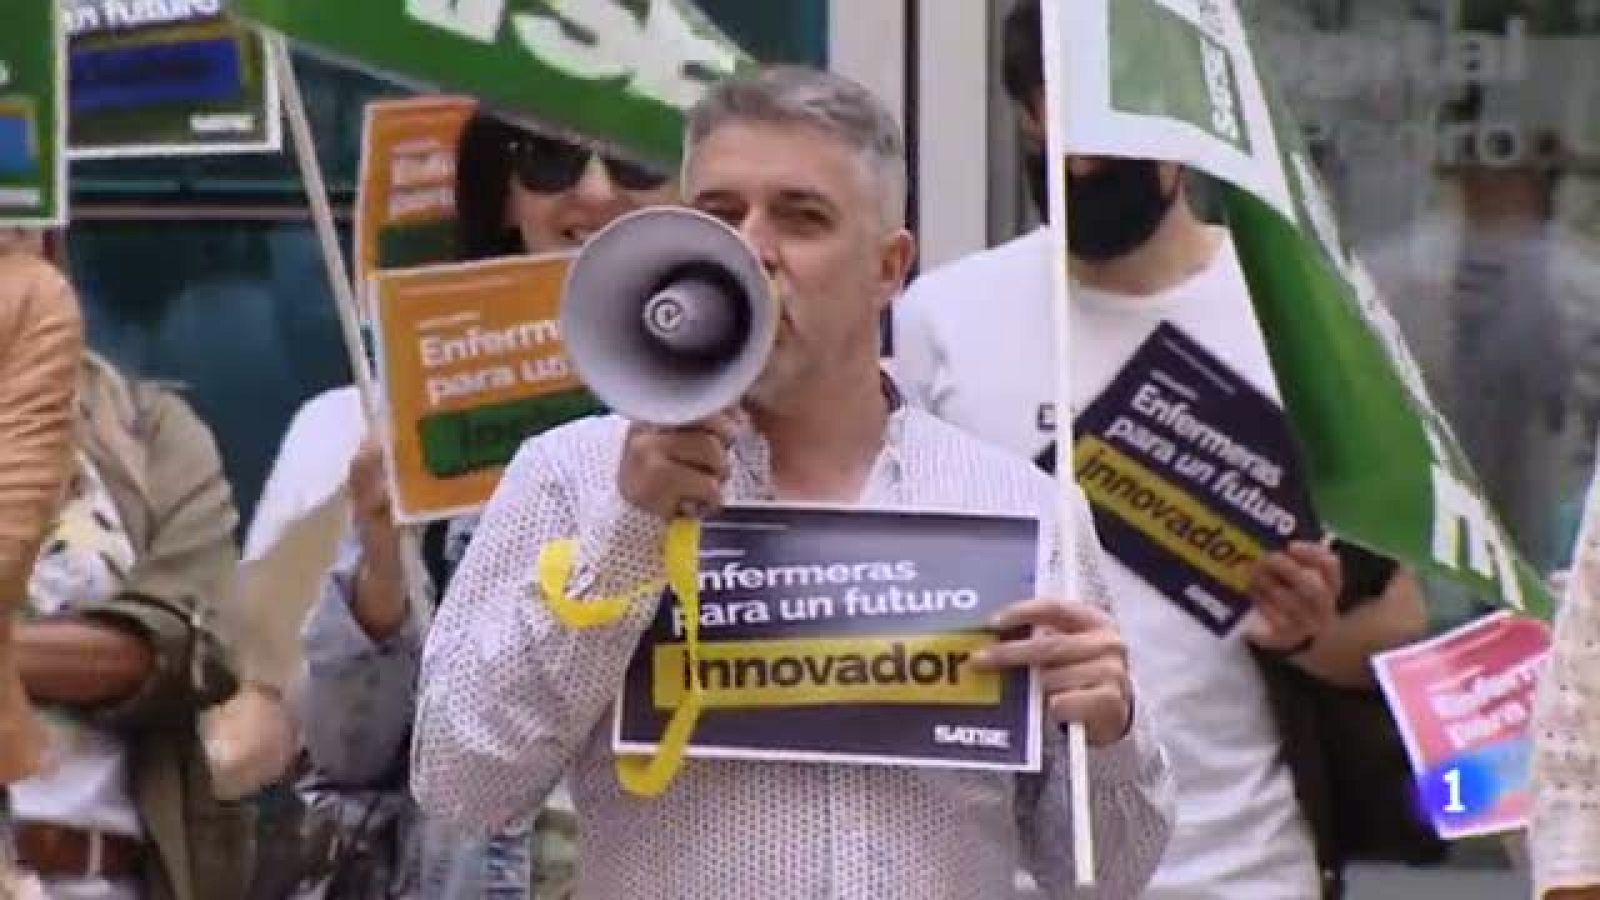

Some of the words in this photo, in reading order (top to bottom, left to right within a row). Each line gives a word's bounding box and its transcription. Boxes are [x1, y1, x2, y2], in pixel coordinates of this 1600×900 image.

[419, 321, 562, 367] Enferm
[427, 366, 517, 406] para
[1130, 383, 1283, 488] Enfermeras
[1103, 415, 1177, 466] para
[1174, 452, 1217, 484] un
[1212, 469, 1298, 536] futuro
[1077, 450, 1250, 571] innovador
[698, 558, 920, 592] nfermeras
[671, 588, 771, 639] para
[779, 597, 834, 622] un
[844, 586, 980, 621] futuro
[681, 643, 972, 691] innovador
[933, 724, 1011, 749] SATSE
